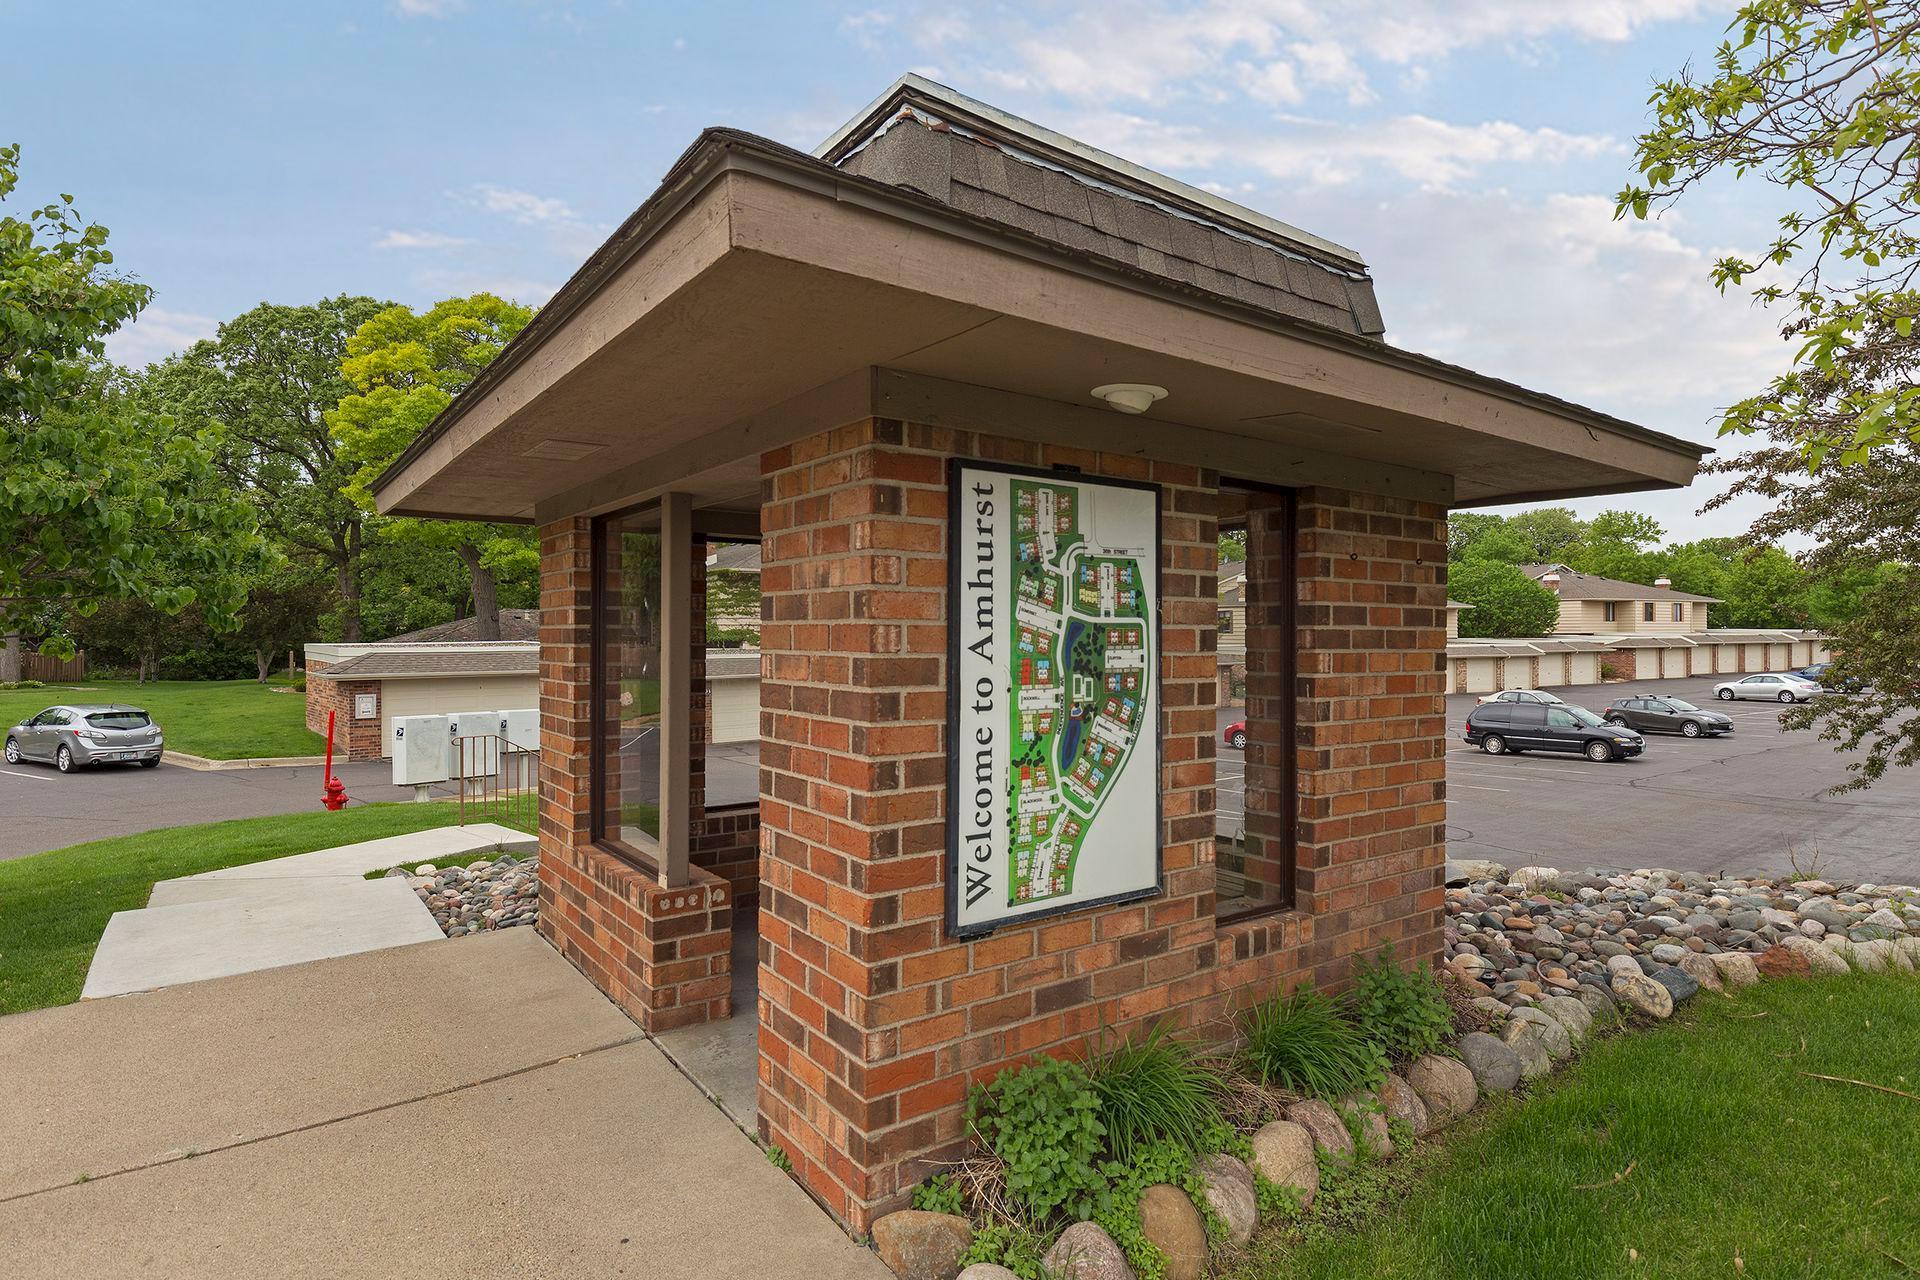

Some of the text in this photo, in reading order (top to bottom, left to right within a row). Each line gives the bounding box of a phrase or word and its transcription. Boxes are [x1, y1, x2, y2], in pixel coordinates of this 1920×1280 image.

[965, 481, 994, 911] Welcome to Amhurst
